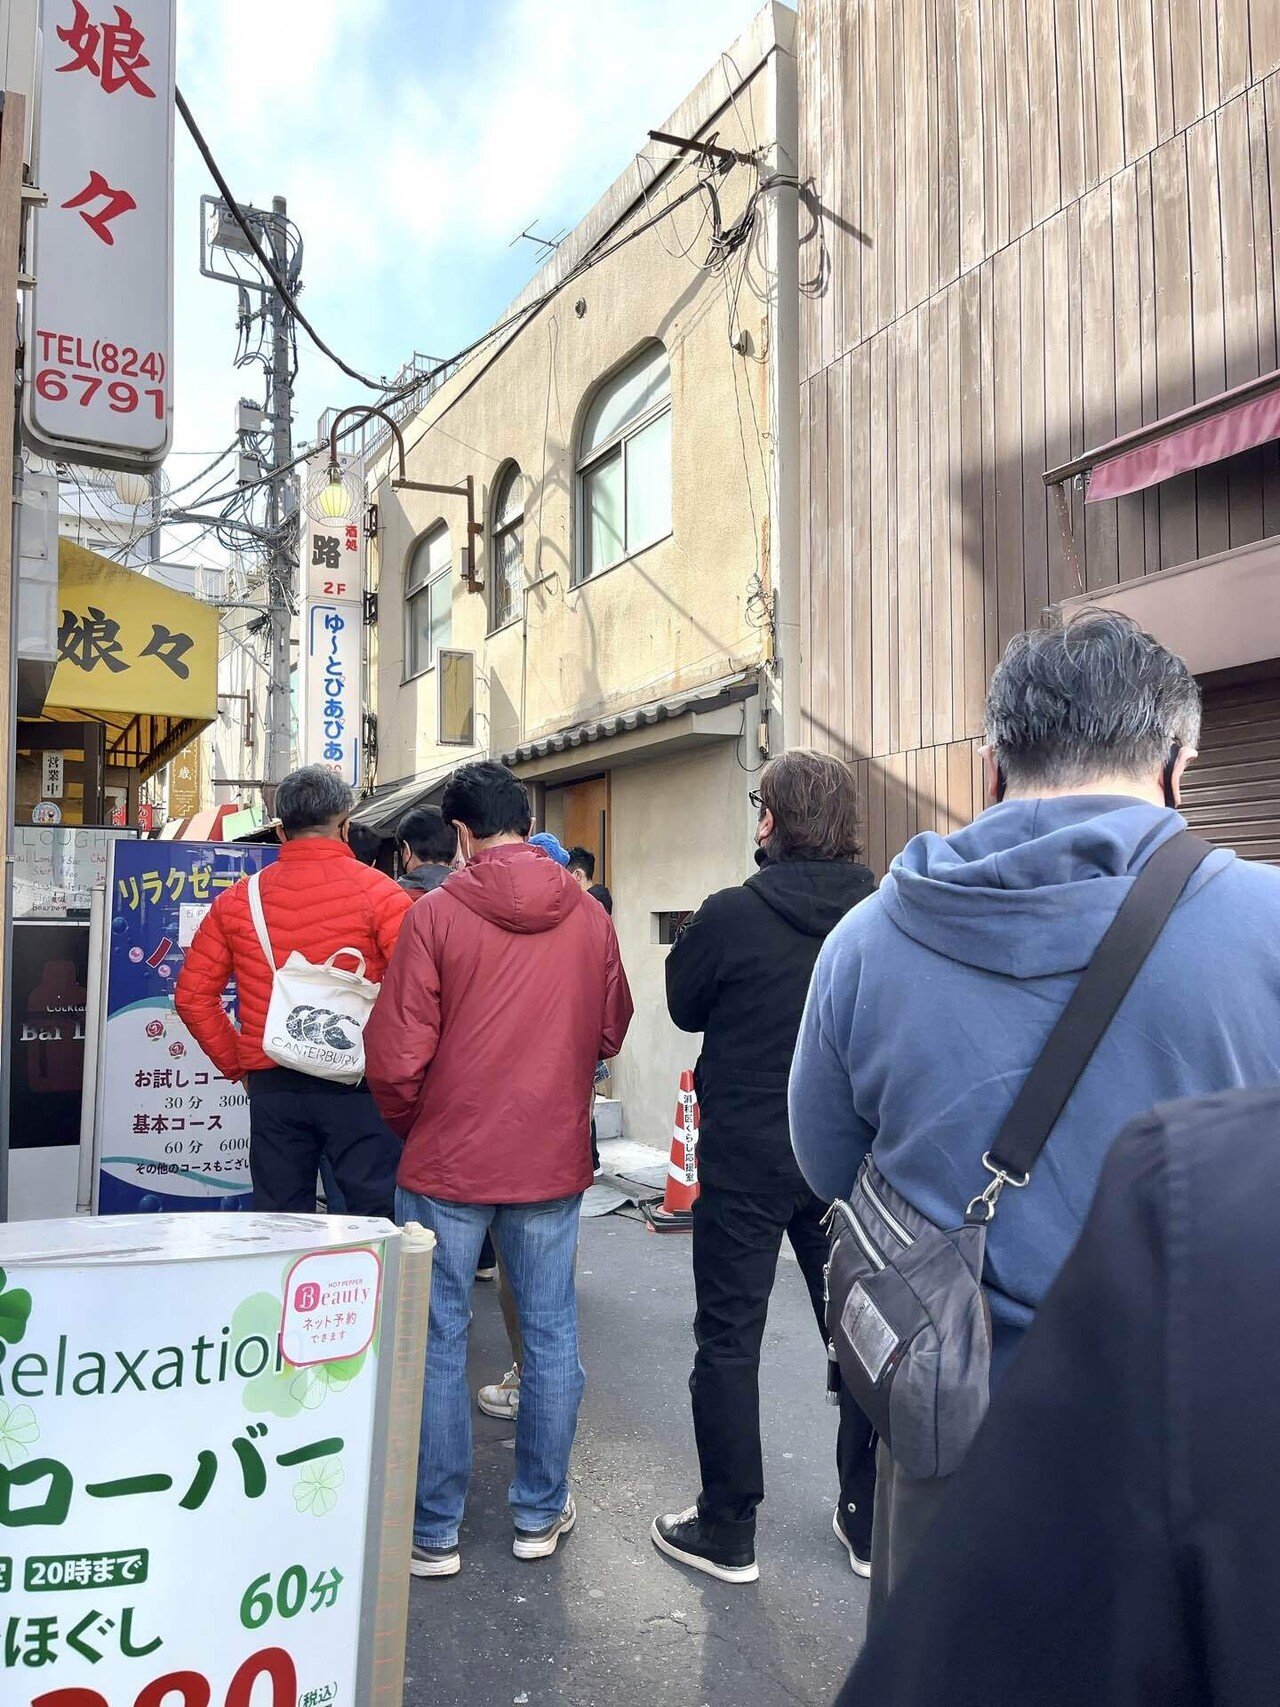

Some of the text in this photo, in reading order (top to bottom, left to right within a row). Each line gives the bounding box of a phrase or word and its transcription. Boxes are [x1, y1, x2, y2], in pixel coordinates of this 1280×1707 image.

[55, 0, 156, 246] 娘々
[37, 330, 165, 383] TEL(824)
[36, 368, 164, 420] 6791
[312, 534, 341, 569] 路
[345, 525, 358, 551] 酒処
[323, 582, 346, 595] 2F
[58, 606, 194, 680] 娘々
[118, 865, 248, 910] リラクゼー
[271, 1036, 359, 1067] CANTERBURY
[135, 1069, 238, 1088] お試しコー
[133, 1114, 222, 1134] 基本コース
[300, 1286, 370, 1309] Beauty
[303, 1311, 357, 1330] ネット予約
[311, 1331, 346, 1344] できます
[30, 1555, 143, 1585] 20時まで
[240, 1565, 344, 1629] 60分
